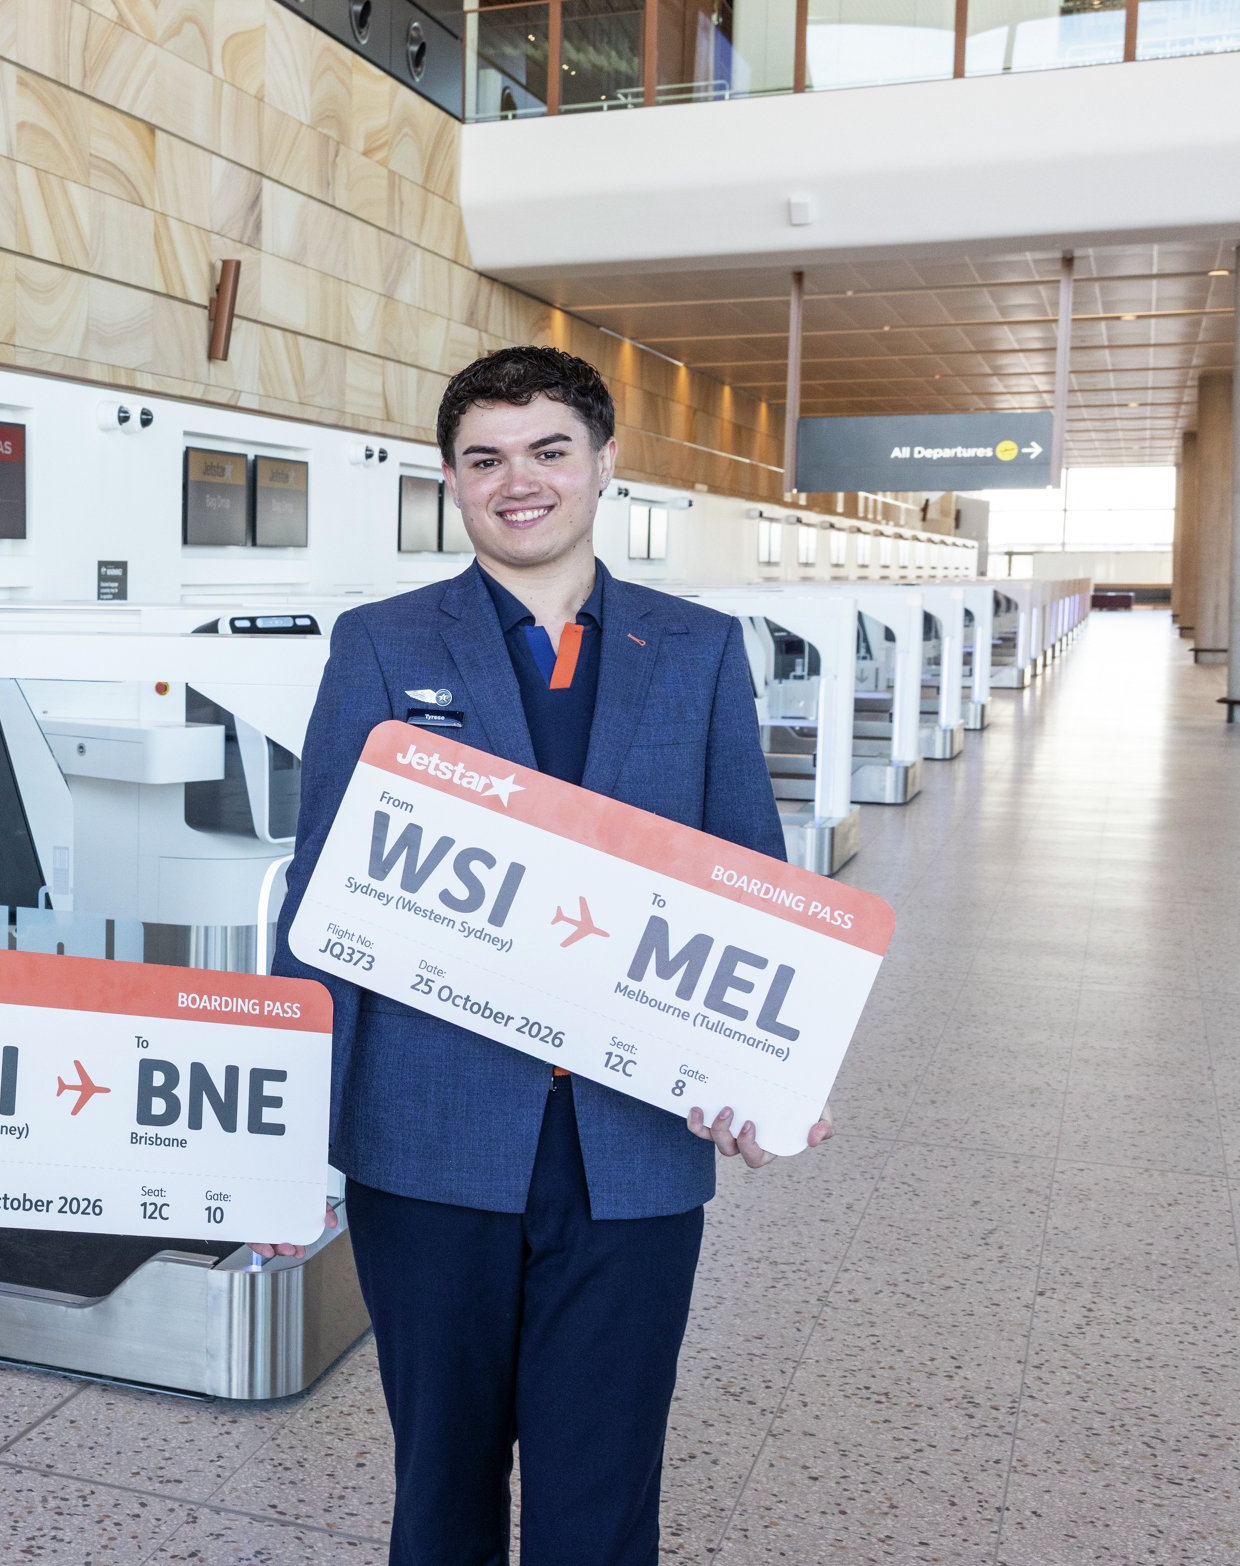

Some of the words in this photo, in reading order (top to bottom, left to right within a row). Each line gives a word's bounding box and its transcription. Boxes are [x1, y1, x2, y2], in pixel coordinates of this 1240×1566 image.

[890, 446, 910, 458] All
[913, 446, 993, 460] Departures
[396, 744, 490, 794] Jetstar
[379, 790, 414, 814] From
[367, 810, 527, 928] WSI
[651, 892, 667, 909] To
[710, 864, 806, 912] BOARDING
[807, 900, 855, 930] PASS
[344, 876, 395, 906] Sydney
[395, 895, 456, 929] (Western
[457, 920, 513, 953] Sydney)
[326, 922, 354, 941] Flight
[356, 934, 374, 950] No:
[318, 938, 376, 972] JQ373
[418, 959, 447, 979] Date:
[626, 914, 801, 1042] MEL
[178, 992, 260, 1015] BOARDING
[264, 1000, 301, 1019] PASS
[409, 973, 436, 995] 25
[437, 985, 515, 1027] October
[515, 1016, 566, 1048] 2026
[613, 981, 691, 1021] Melbourne
[692, 1012, 790, 1062] (Tullamarine)
[134, 1035, 149, 1049] To
[609, 1036, 638, 1055] Seat:
[604, 1051, 637, 1078] 12C
[679, 1063, 709, 1084] Gate:
[136, 1058, 288, 1137] BNE
[671, 1079, 687, 1097] 8
[130, 1131, 188, 1148] Brisbane
[141, 1185, 167, 1198] Seat:
[205, 1190, 232, 1202] Gate:
[57, 1196, 103, 1217] 2026
[140, 1201, 170, 1221] 12C
[204, 1206, 225, 1224] 10
